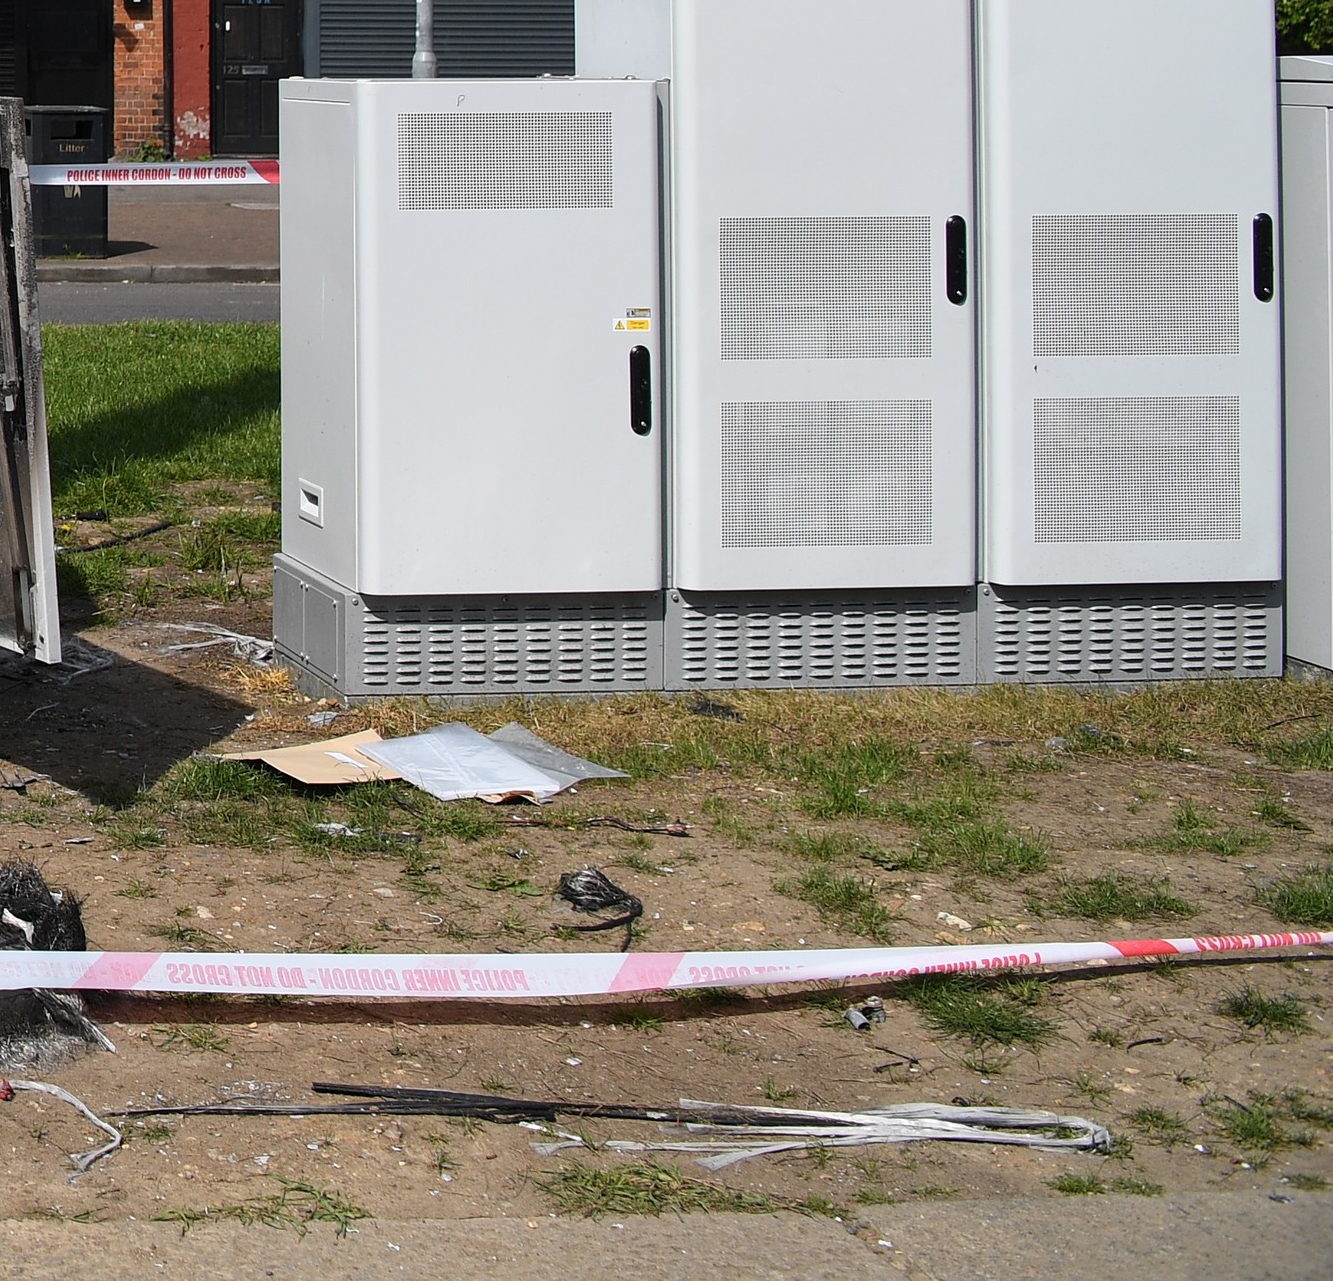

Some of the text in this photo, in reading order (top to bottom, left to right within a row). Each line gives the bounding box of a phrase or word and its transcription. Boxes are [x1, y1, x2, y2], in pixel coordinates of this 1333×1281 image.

[59, 143, 86, 153] Litter
[67, 170, 100, 182] POLICE
[101, 169, 130, 181] INNER
[131, 168, 171, 181] CORDON
[178, 167, 192, 180] DO
[193, 167, 213, 179] NOT
[214, 166, 247, 179] CROSS
